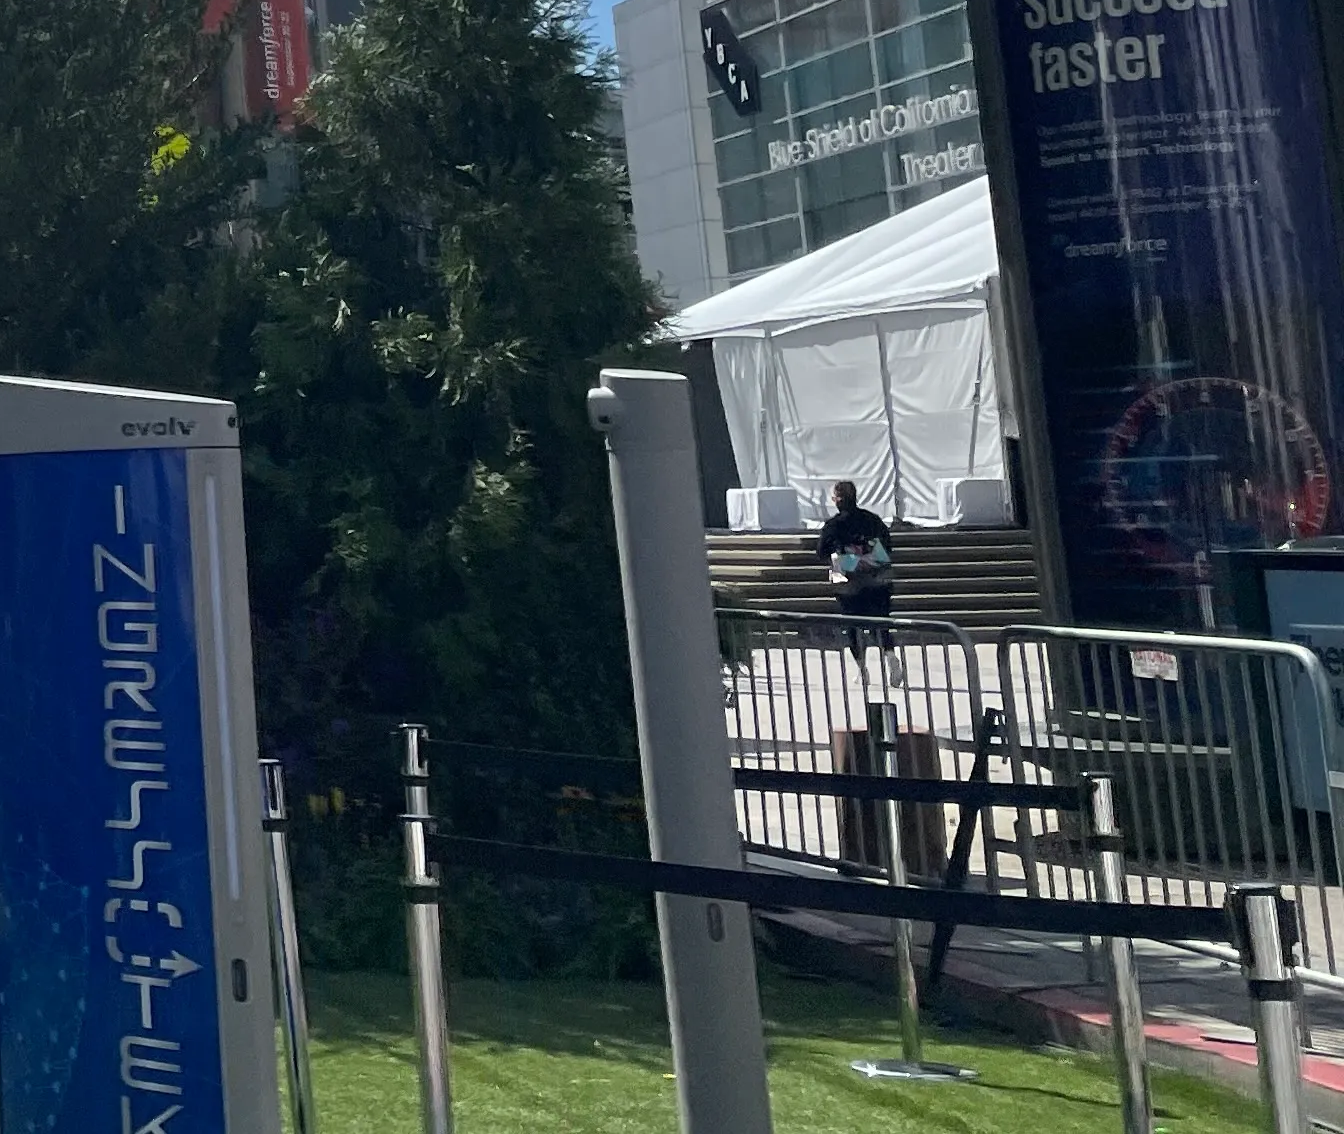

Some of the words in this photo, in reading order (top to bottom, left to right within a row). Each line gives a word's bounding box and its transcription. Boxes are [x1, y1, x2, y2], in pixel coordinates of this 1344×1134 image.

[258, 1, 280, 99] dreamforce
[1029, 32, 1166, 95] faster
[120, 416, 198, 437] evolv
